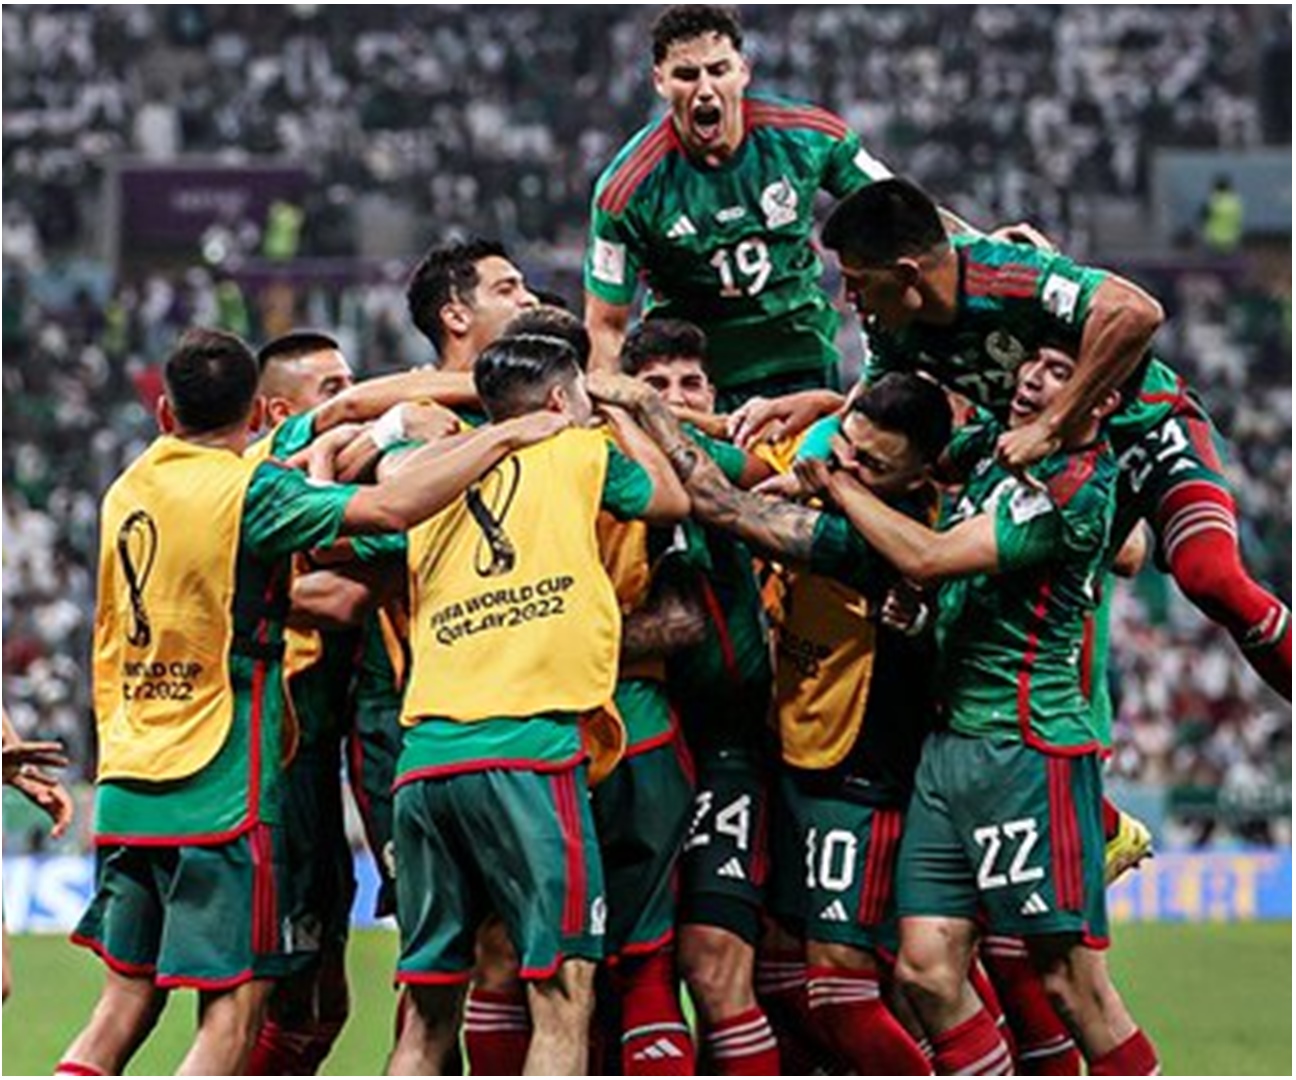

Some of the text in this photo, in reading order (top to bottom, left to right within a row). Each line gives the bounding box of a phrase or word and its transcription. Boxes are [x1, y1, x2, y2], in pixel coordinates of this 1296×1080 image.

[710, 238, 771, 297] 19
[431, 575, 575, 629] FIFA WORLD CUP
[169, 661, 203, 679] CUP
[684, 791, 751, 851] 24
[806, 828, 858, 892] 10
[973, 816, 1045, 891] 22
